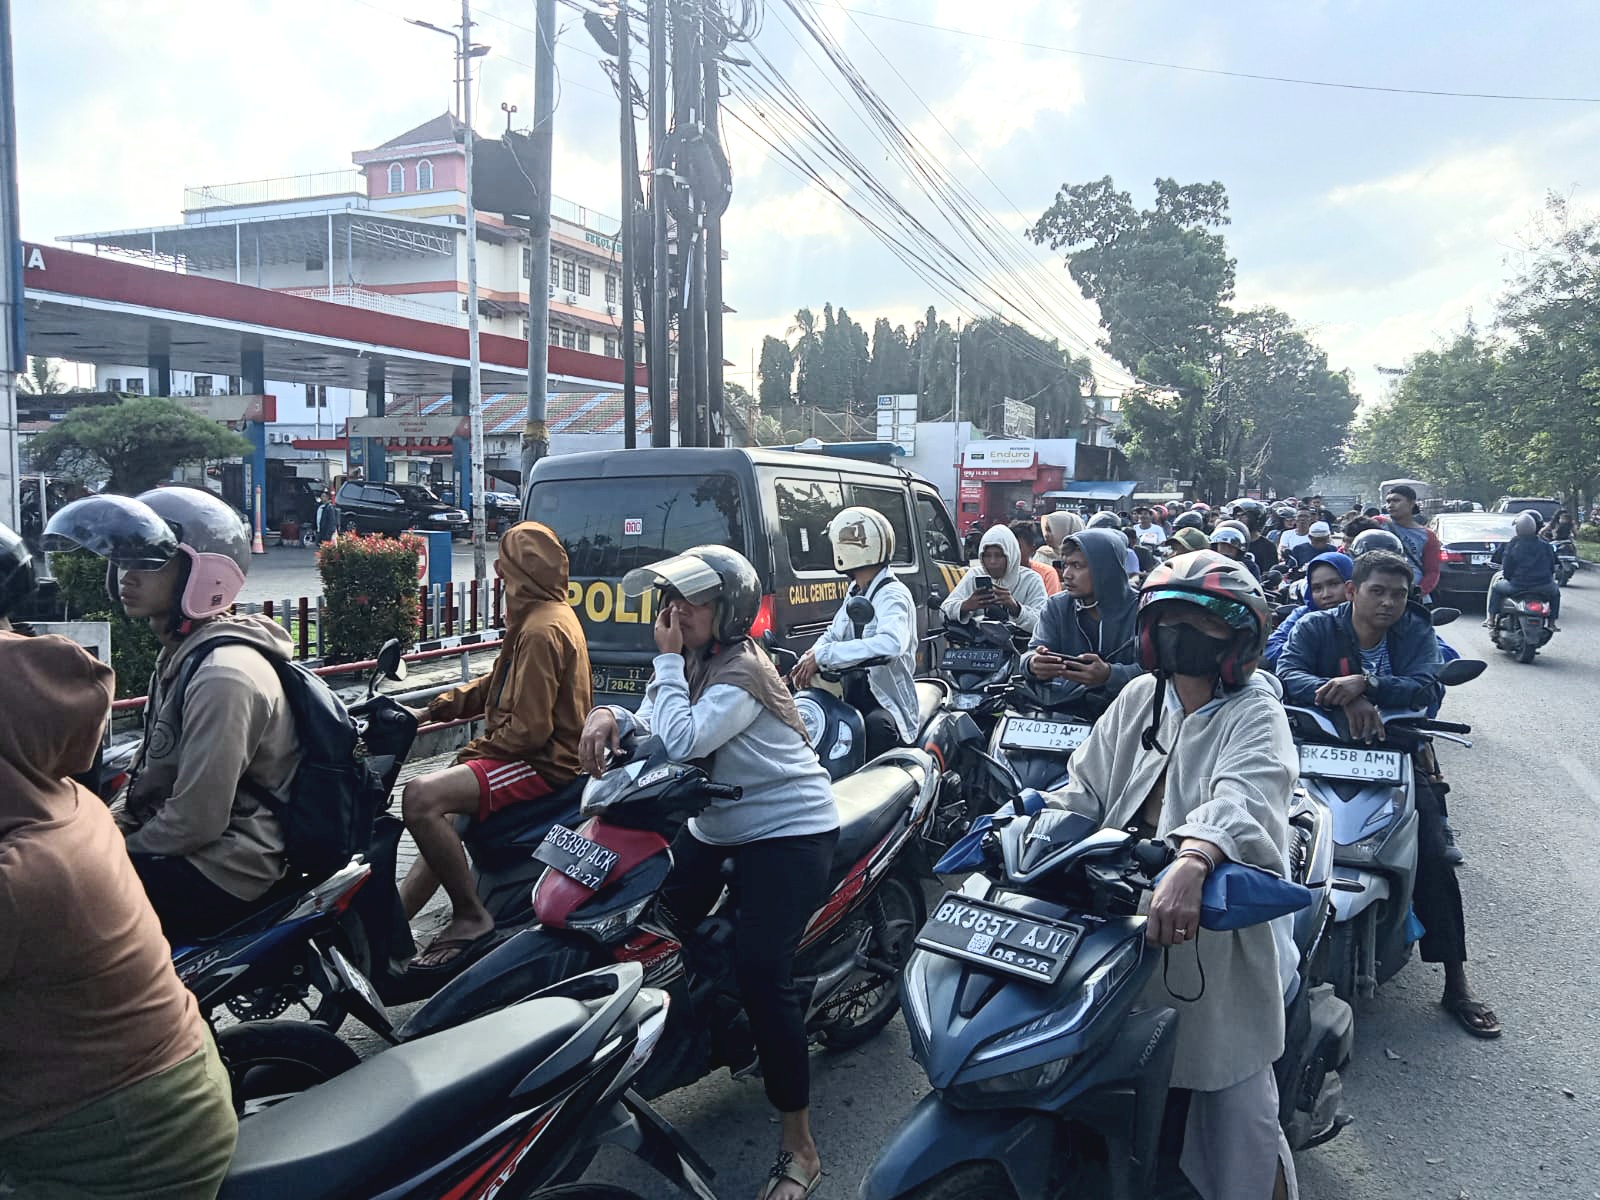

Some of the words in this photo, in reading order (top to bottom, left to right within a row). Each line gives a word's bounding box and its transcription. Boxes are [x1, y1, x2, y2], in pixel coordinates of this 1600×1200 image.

[789, 584, 809, 605] CALL
[810, 582, 837, 602] CENTER
[1364, 751, 1395, 766] AMN
[586, 847, 617, 872] ACK
[1020, 926, 1070, 954] AJV
[1139, 1020, 1167, 1067] HONDA
